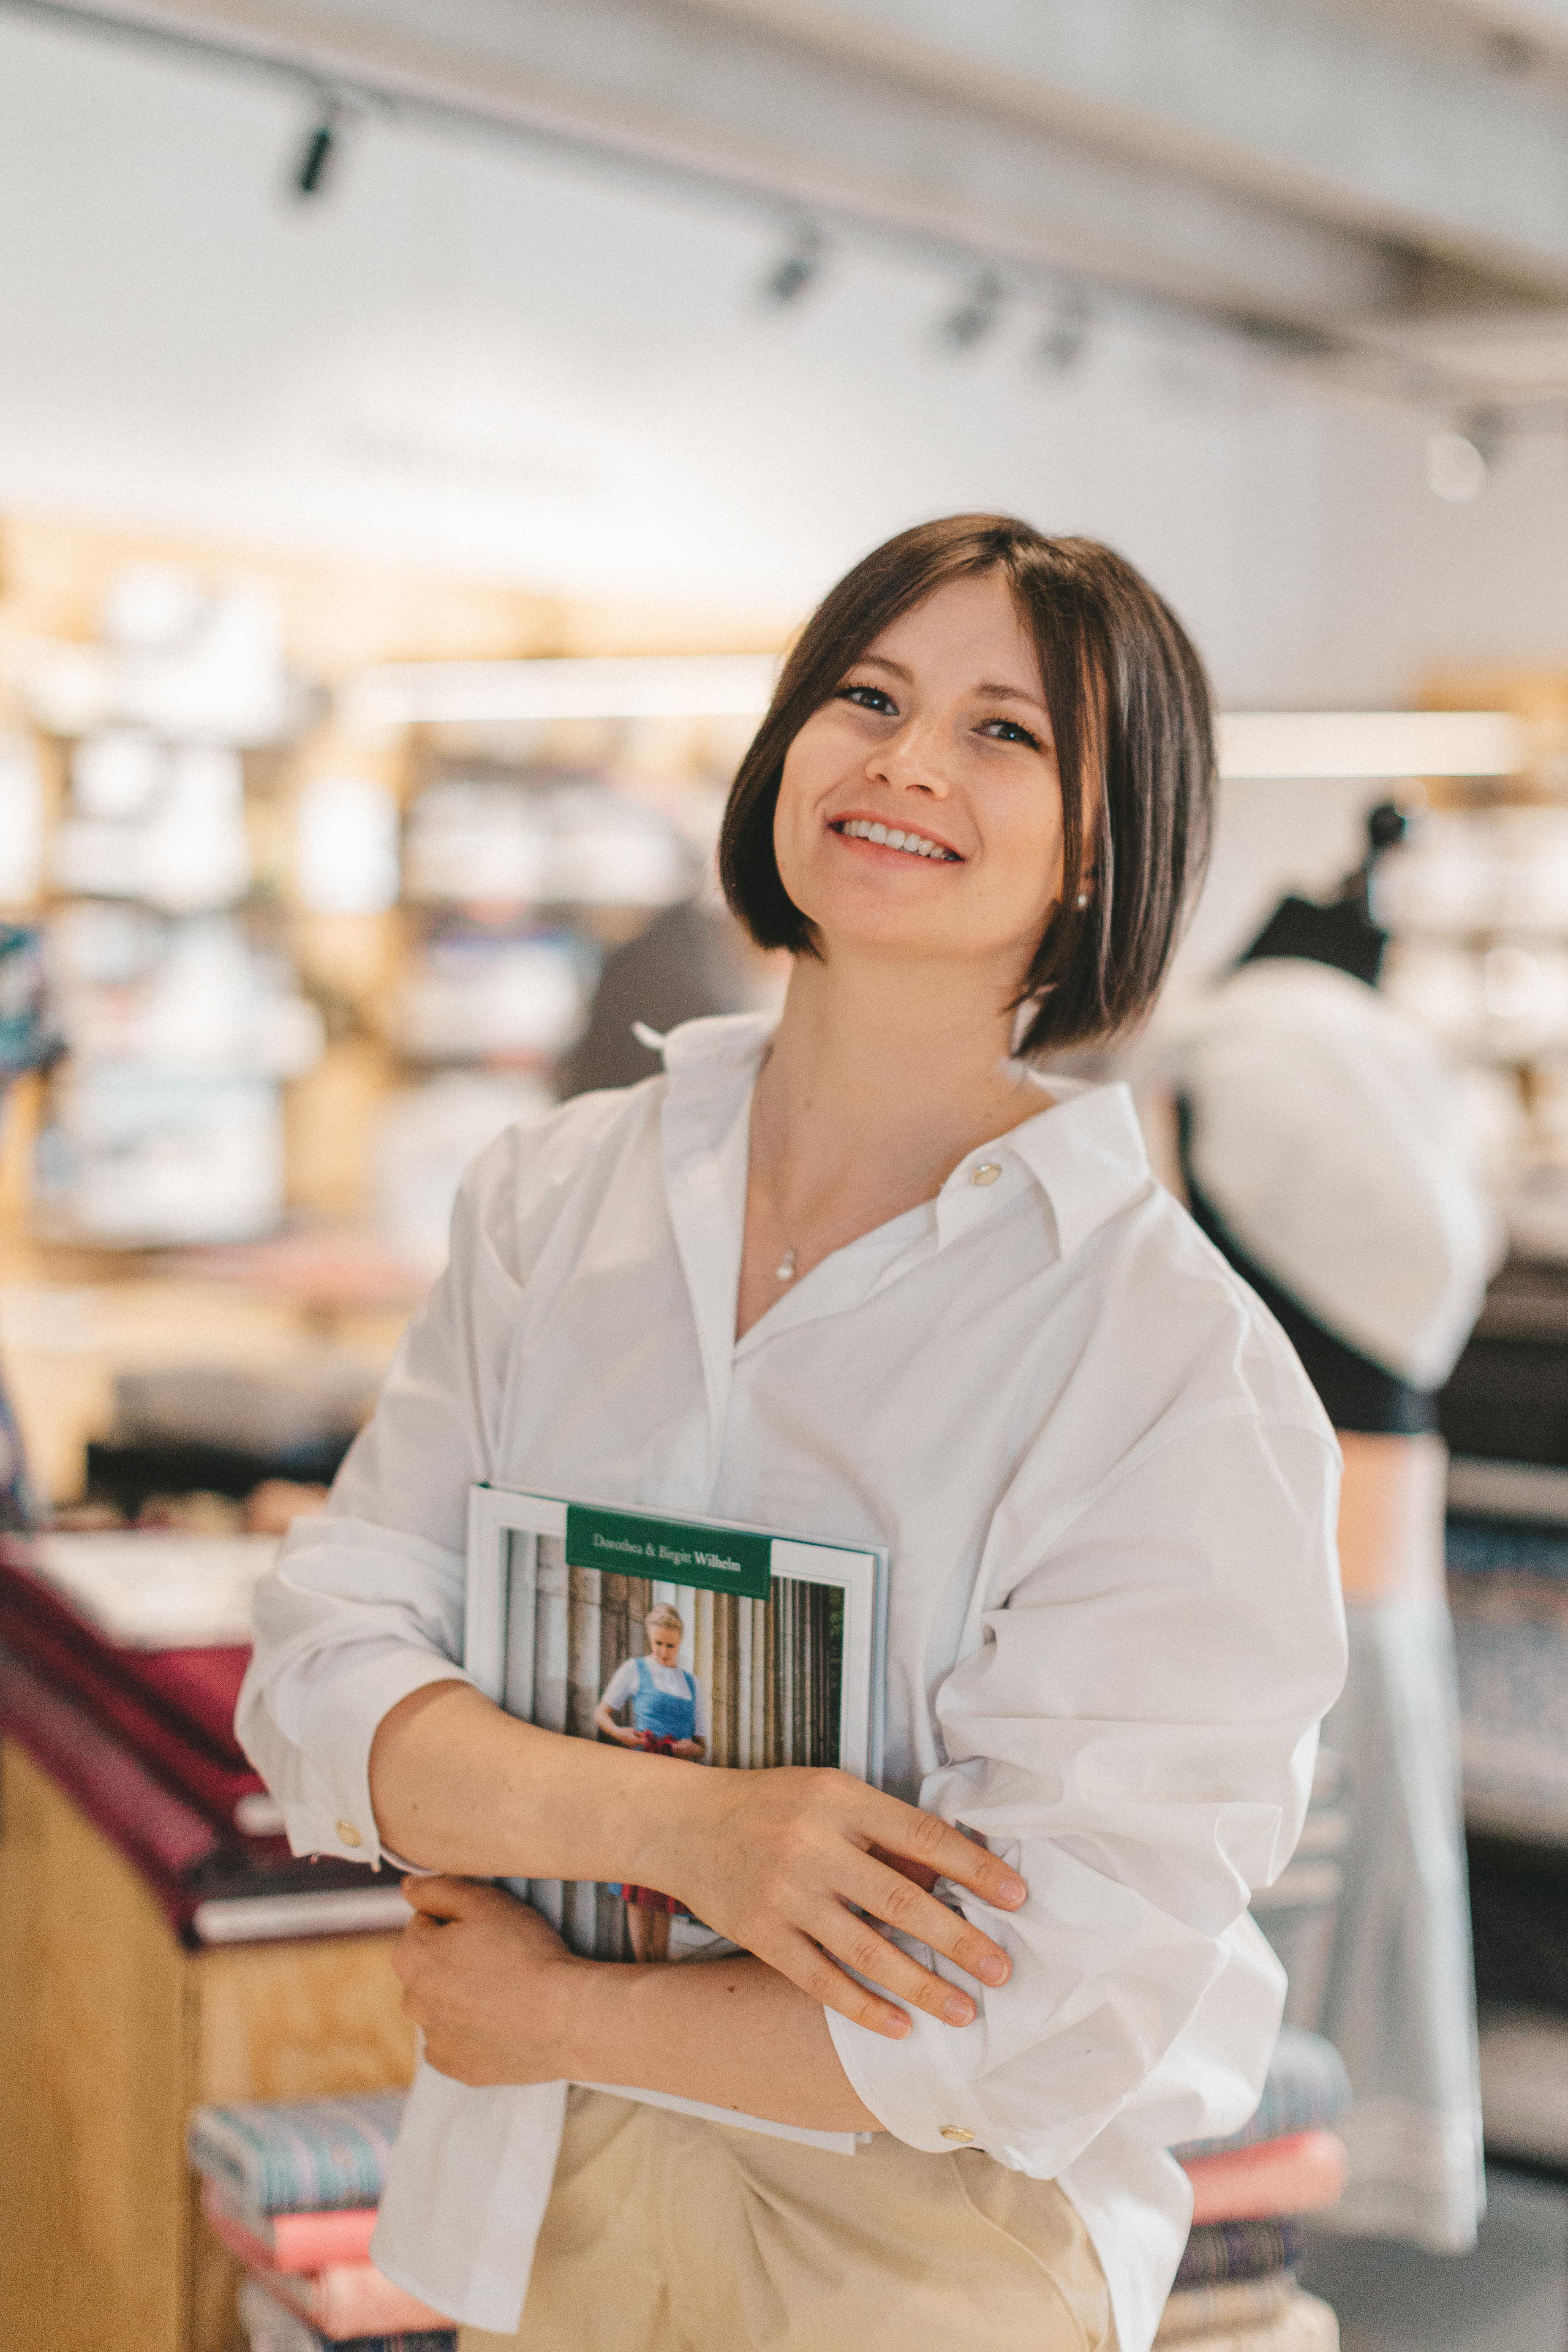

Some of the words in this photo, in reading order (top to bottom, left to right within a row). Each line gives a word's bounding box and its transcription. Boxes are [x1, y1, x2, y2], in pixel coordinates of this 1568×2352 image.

[593, 1534, 643, 1555] Dorothea
[645, 1543, 655, 1556] &
[694, 1551, 741, 1572] Wilhelm
